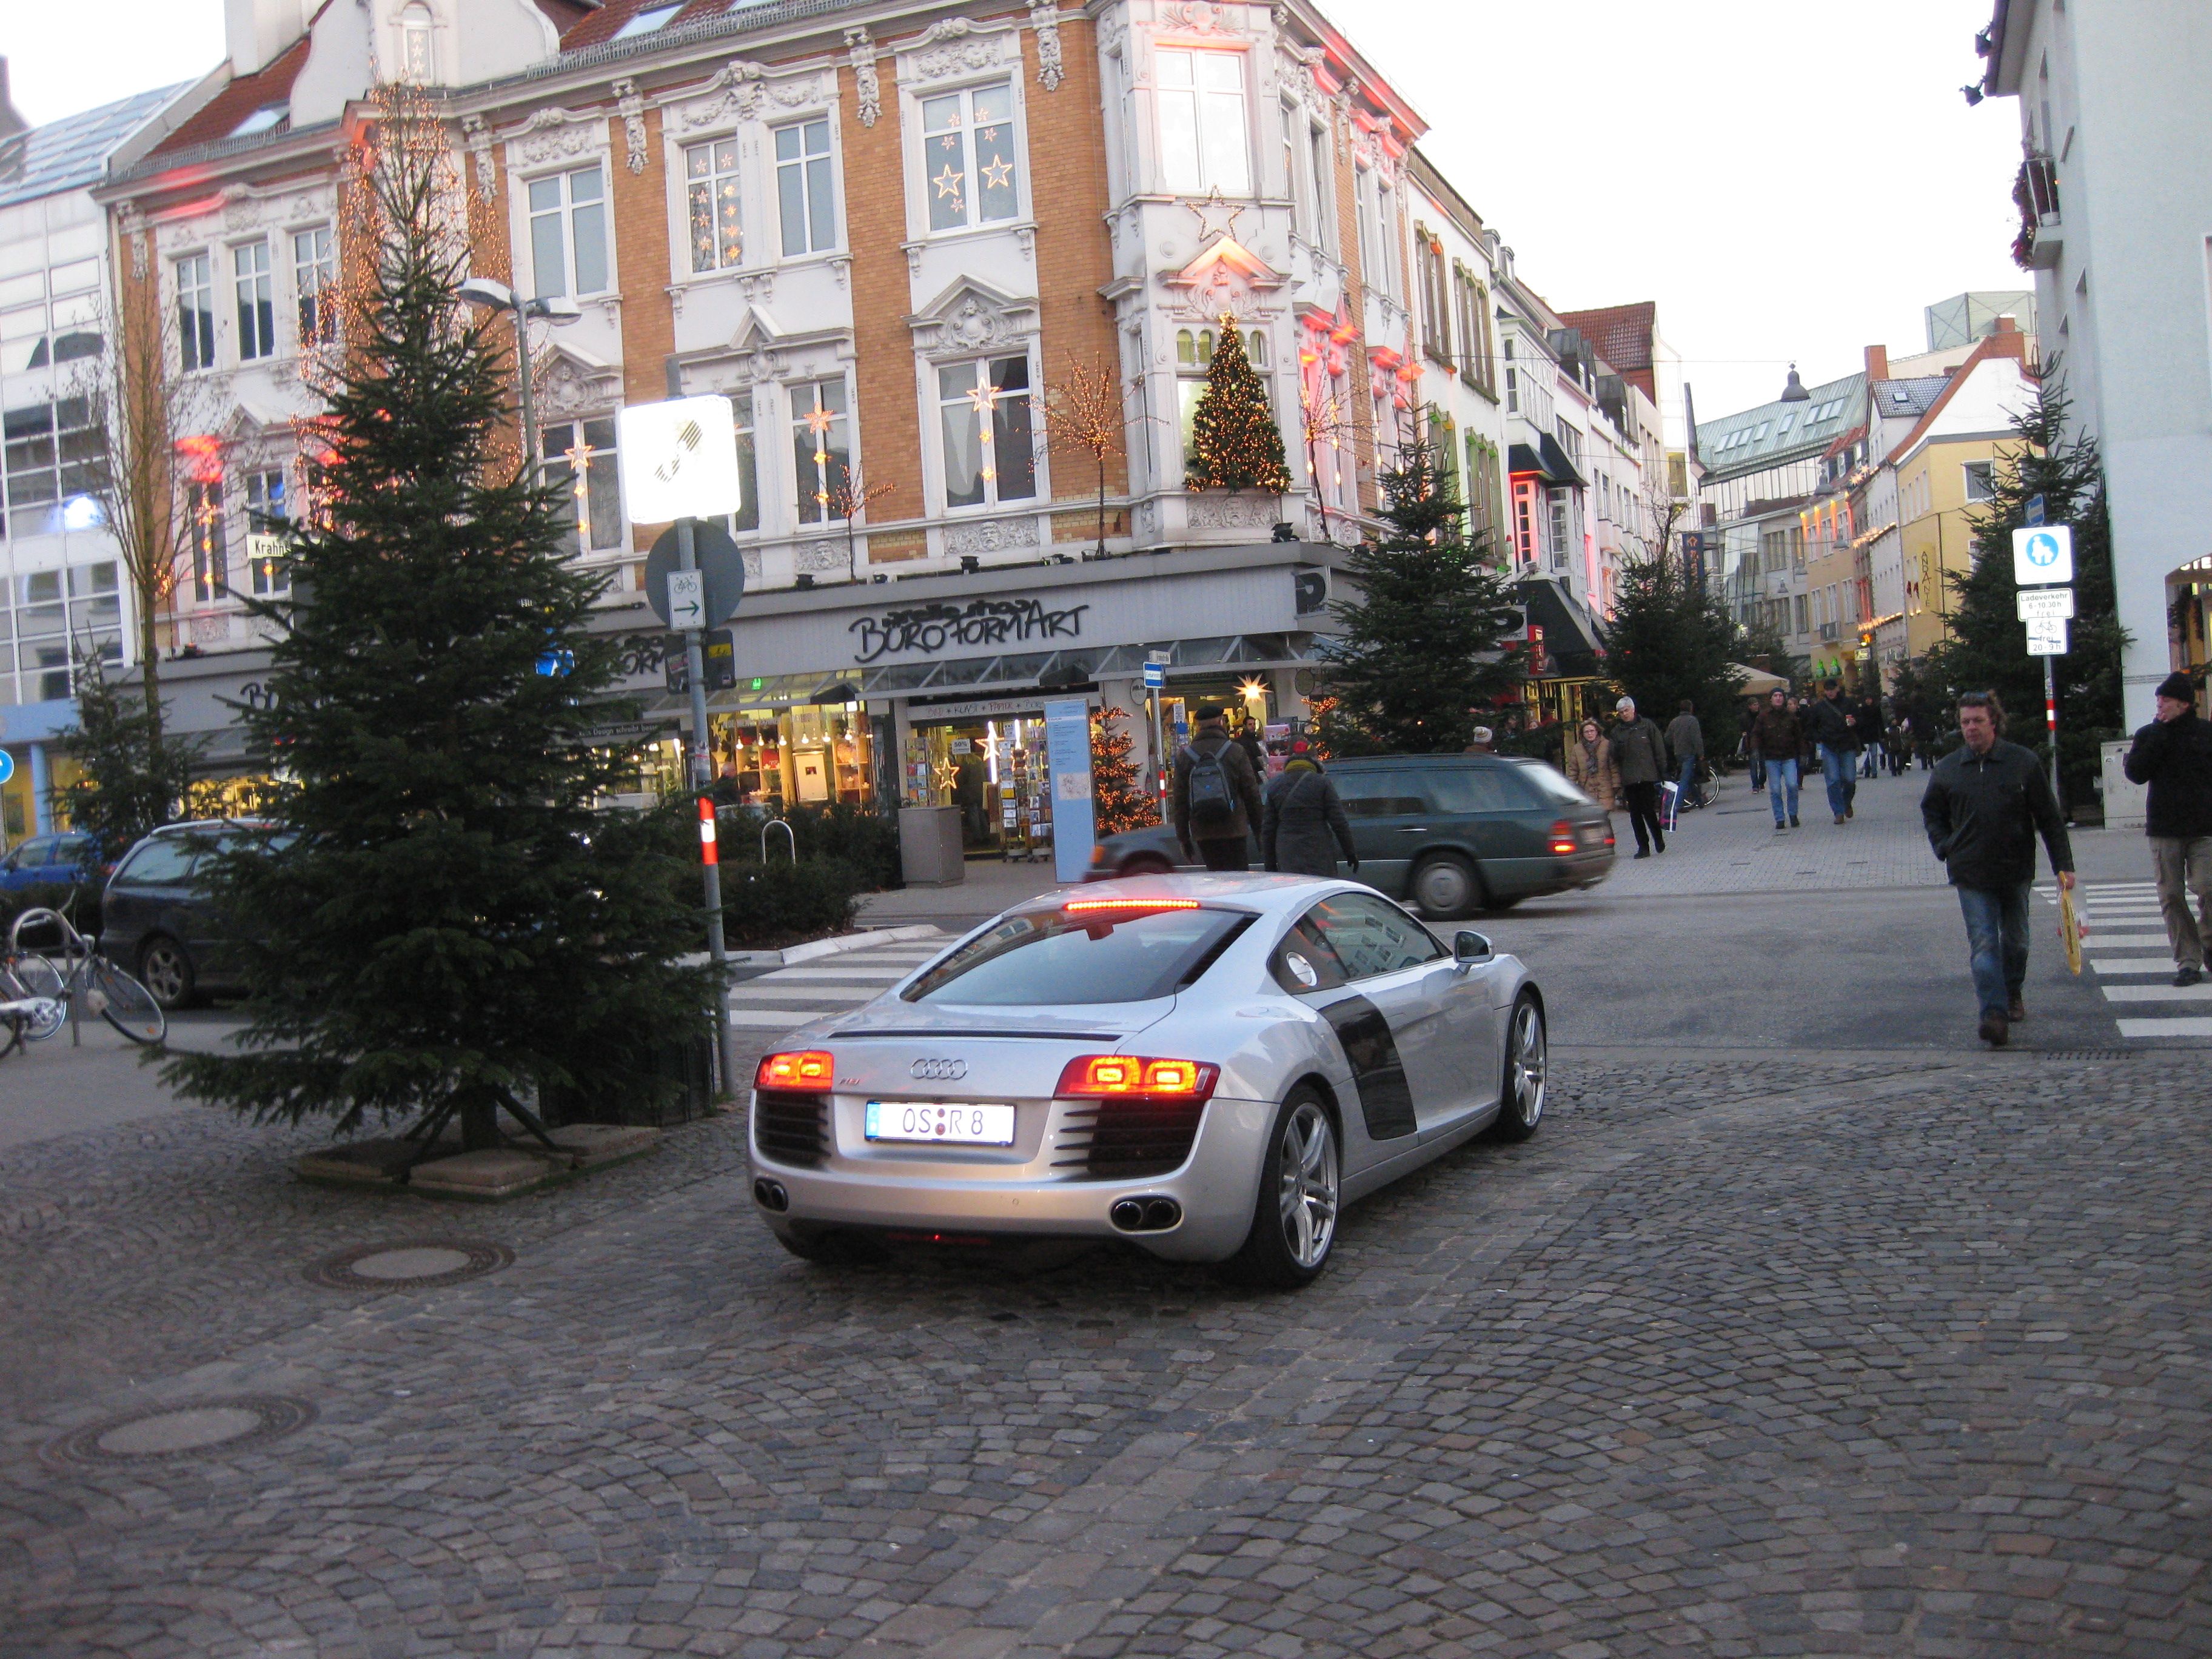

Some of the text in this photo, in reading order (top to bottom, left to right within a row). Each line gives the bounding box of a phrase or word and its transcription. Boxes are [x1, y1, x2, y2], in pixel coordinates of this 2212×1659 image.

[255, 539, 288, 555] Krahn
[1921, 551, 1932, 606] ANDANTE
[2021, 593, 2068, 602] Ladeverkehr
[903, 1108, 931, 1133] OS
